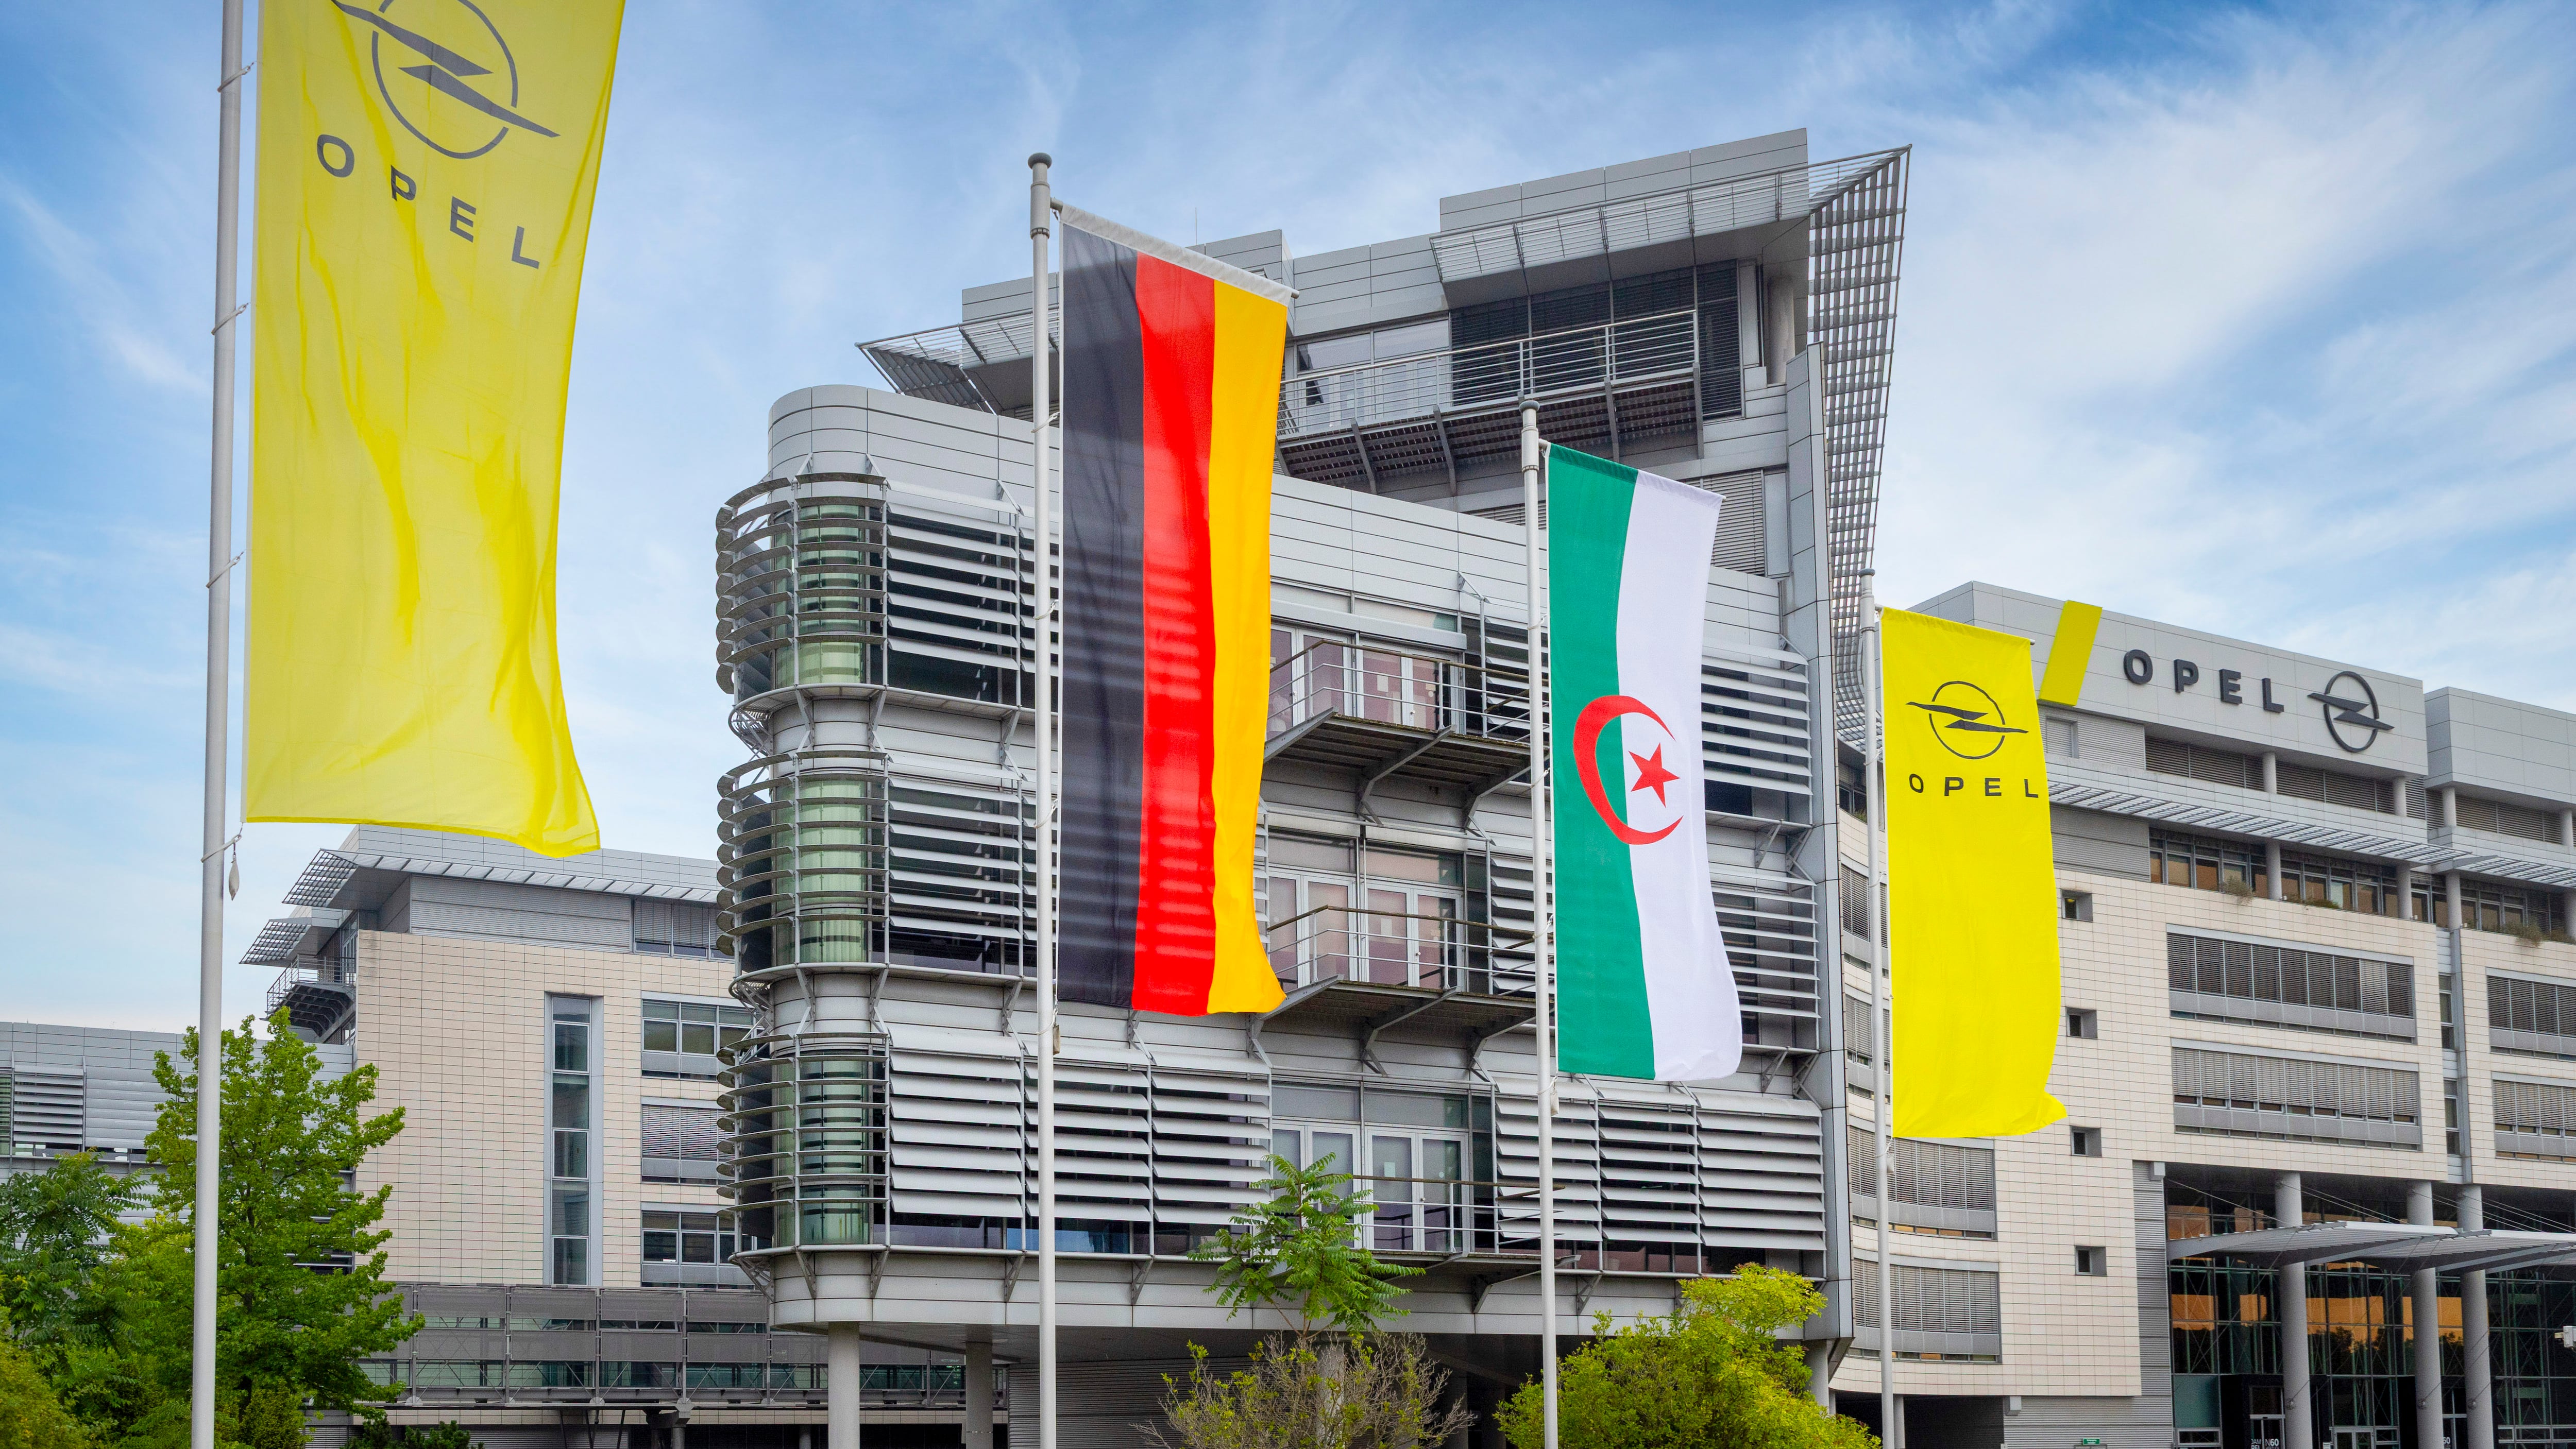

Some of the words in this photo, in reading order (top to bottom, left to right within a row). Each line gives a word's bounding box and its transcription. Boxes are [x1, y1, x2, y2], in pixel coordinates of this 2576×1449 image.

[316, 134, 540, 270] OPEL
[2123, 649, 2284, 713] OPEL
[1909, 773, 2039, 798] OPEL
